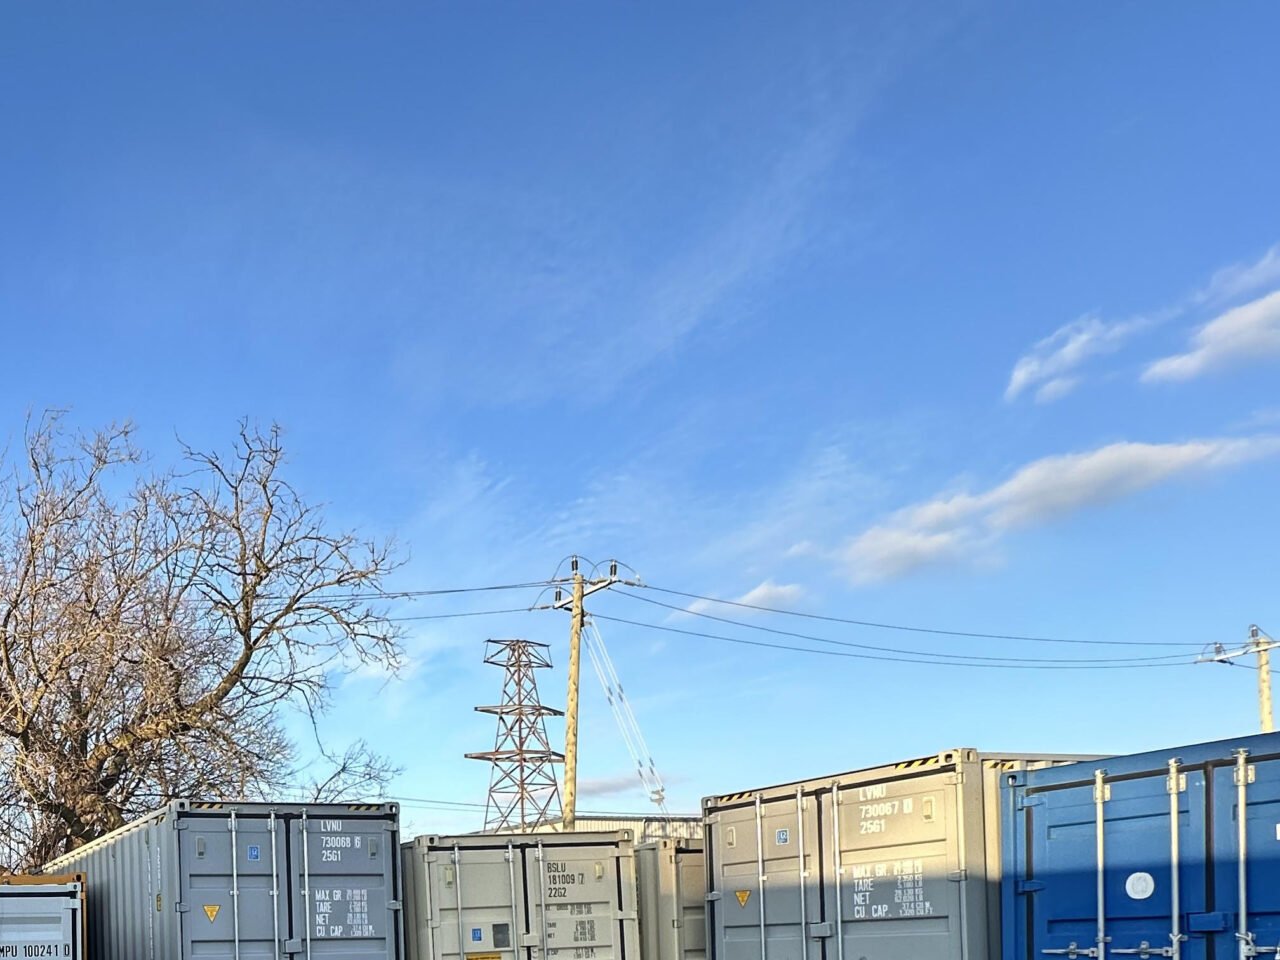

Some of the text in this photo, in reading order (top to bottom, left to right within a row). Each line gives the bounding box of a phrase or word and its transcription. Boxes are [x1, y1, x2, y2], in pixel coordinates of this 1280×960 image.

[859, 801, 899, 818] 730067
[320, 819, 342, 831] LVNU
[321, 836, 351, 848] 730068
[321, 850, 341, 861] 25G1
[547, 862, 566, 873] BSLU
[548, 873, 575, 885] 181009
[853, 879, 875, 892] TARE
[548, 886, 567, 898] 22G2
[853, 892, 870, 905] NET
[316, 901, 333, 913] TARE
[315, 913, 330, 925] NET
[23, 944, 59, 958] 100241
